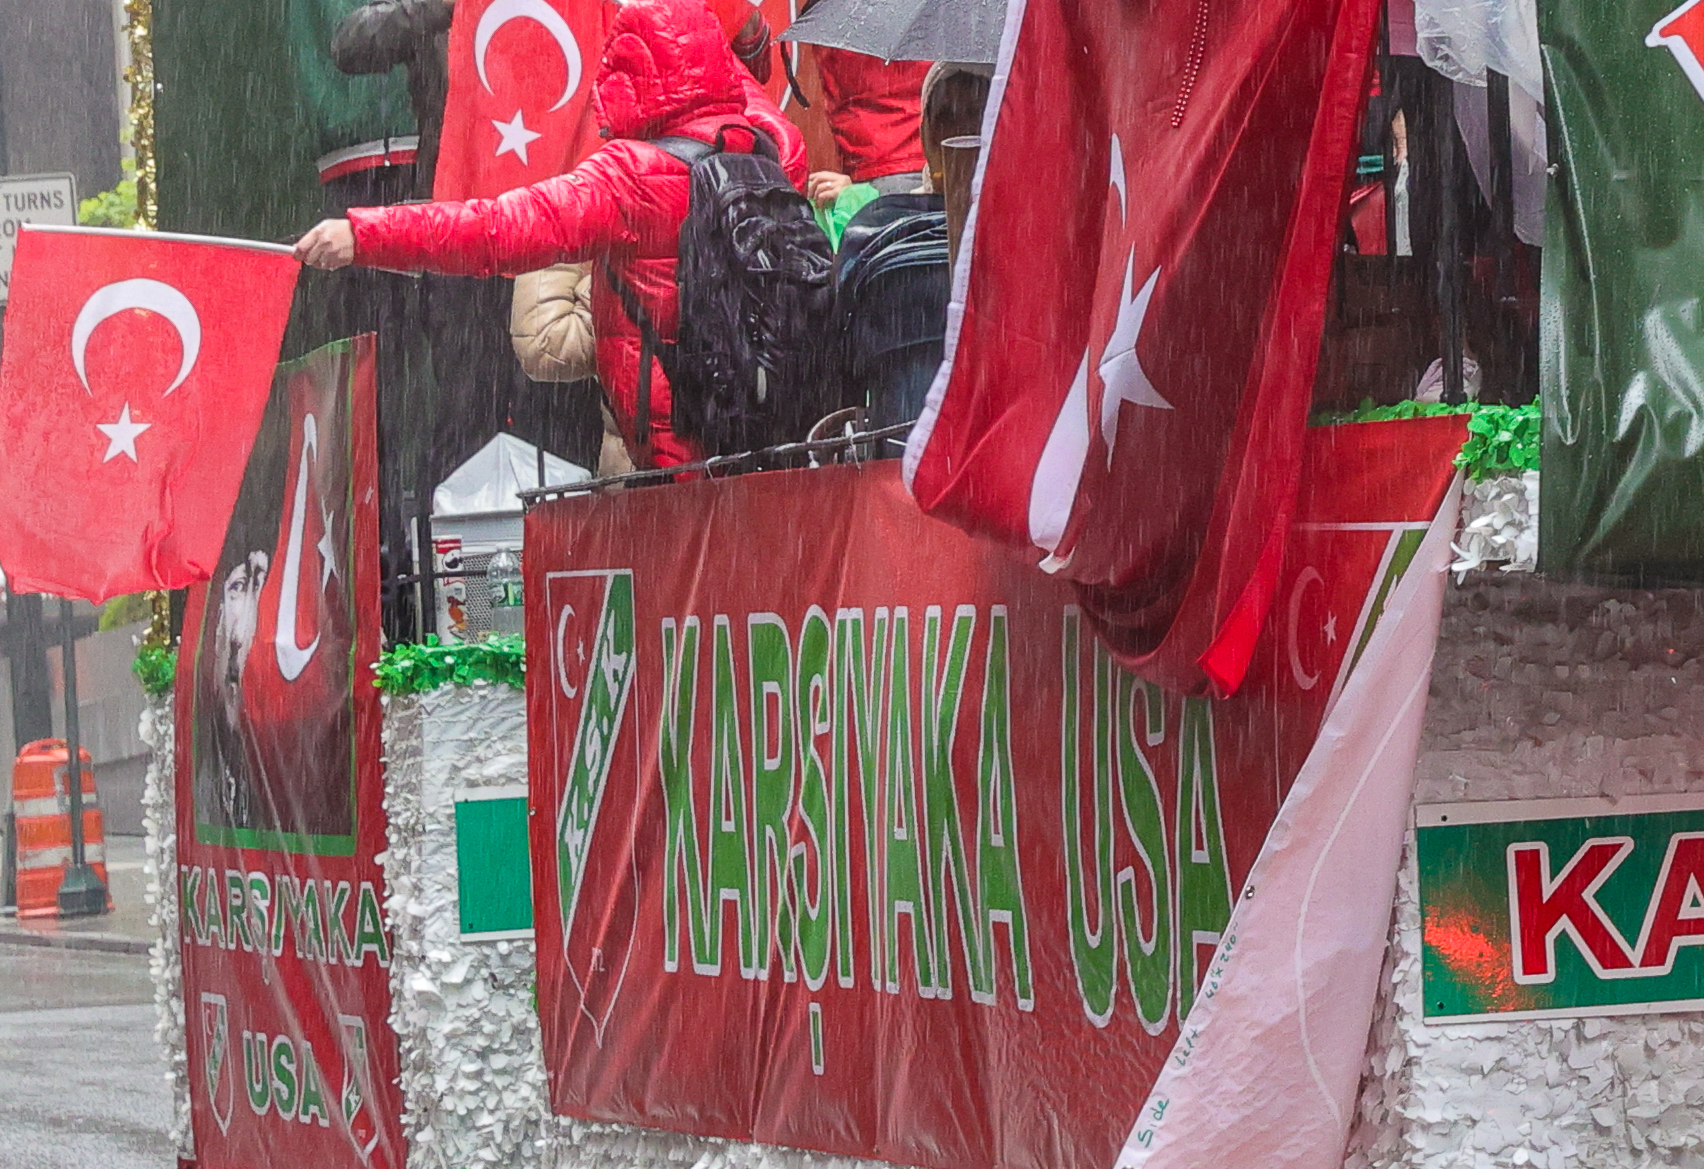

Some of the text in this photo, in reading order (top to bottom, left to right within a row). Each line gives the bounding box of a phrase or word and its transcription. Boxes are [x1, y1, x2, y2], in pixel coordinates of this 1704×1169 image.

[3, 190, 65, 212] TURNS
[1060, 604, 1239, 1037] USA
[242, 1030, 330, 1128] USA
